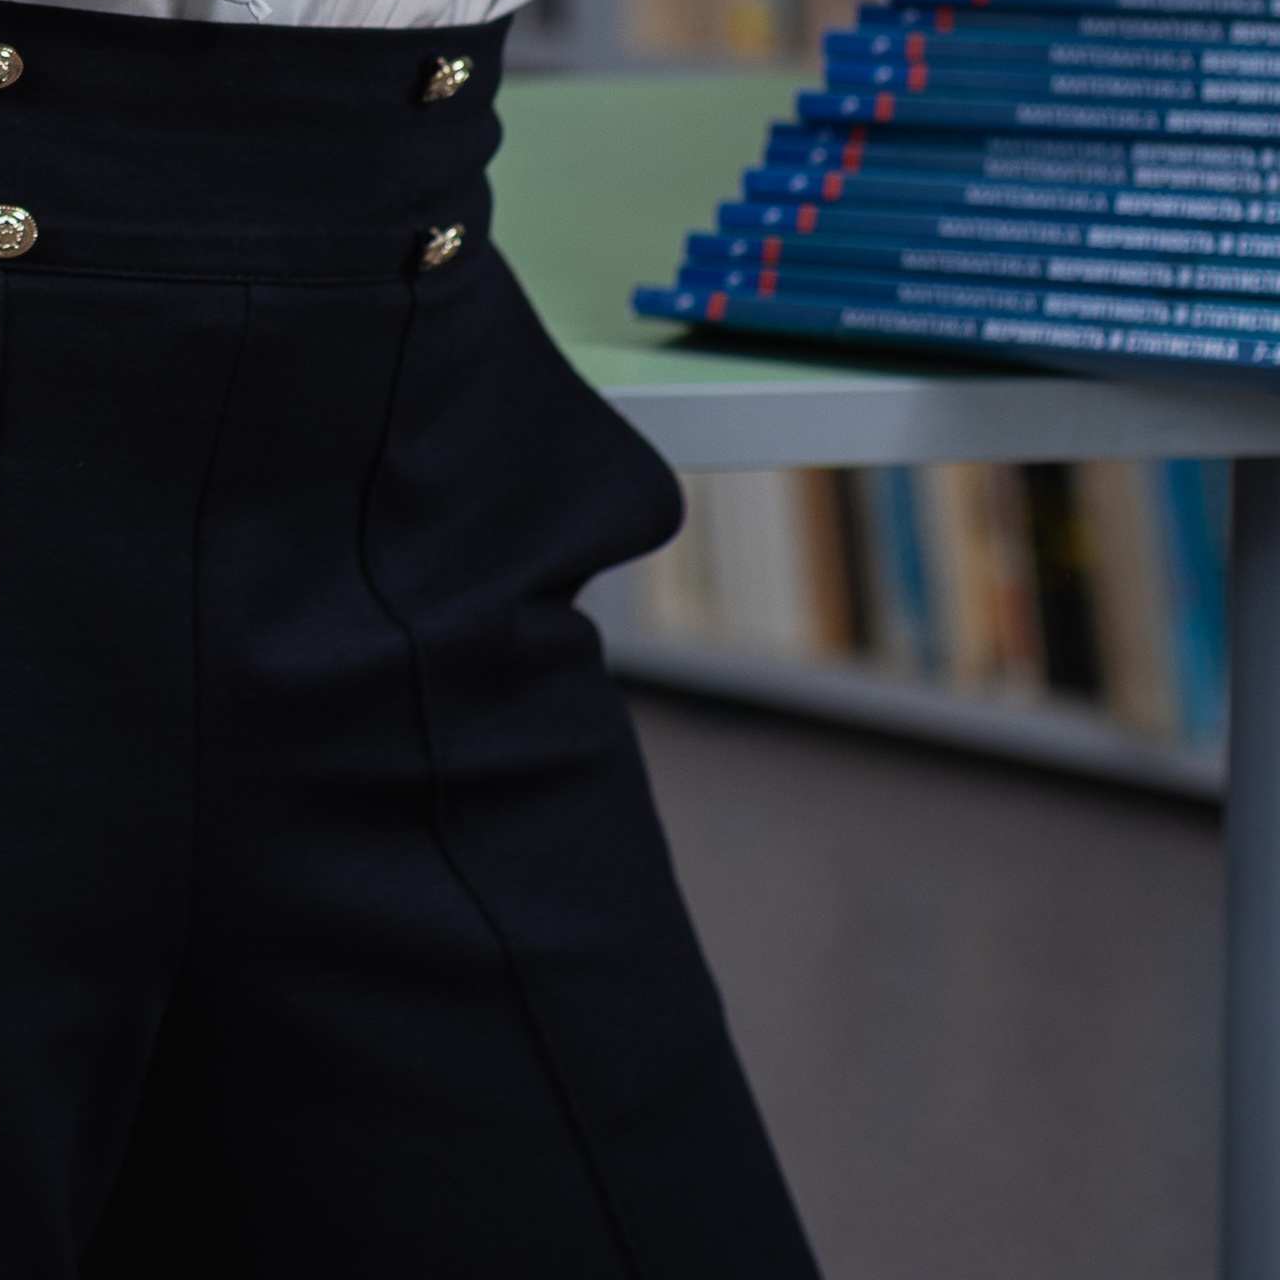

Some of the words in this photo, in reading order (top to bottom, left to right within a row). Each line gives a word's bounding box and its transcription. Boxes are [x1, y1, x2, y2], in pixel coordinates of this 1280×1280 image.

[1114, 192, 1244, 222] ВЕРОЯТНОСТЬ
[1087, 224, 1216, 254] ВЕРОЯТНОСТЬ
[1046, 257, 1175, 287] ВЕРОЯТНОСТЬ
[1043, 293, 1171, 325] ВЕРОЯТНОСТЬ
[982, 318, 1106, 350] ВЕРОЯТНОСТЬ
[1125, 329, 1239, 362] СТАТИСТИКА
